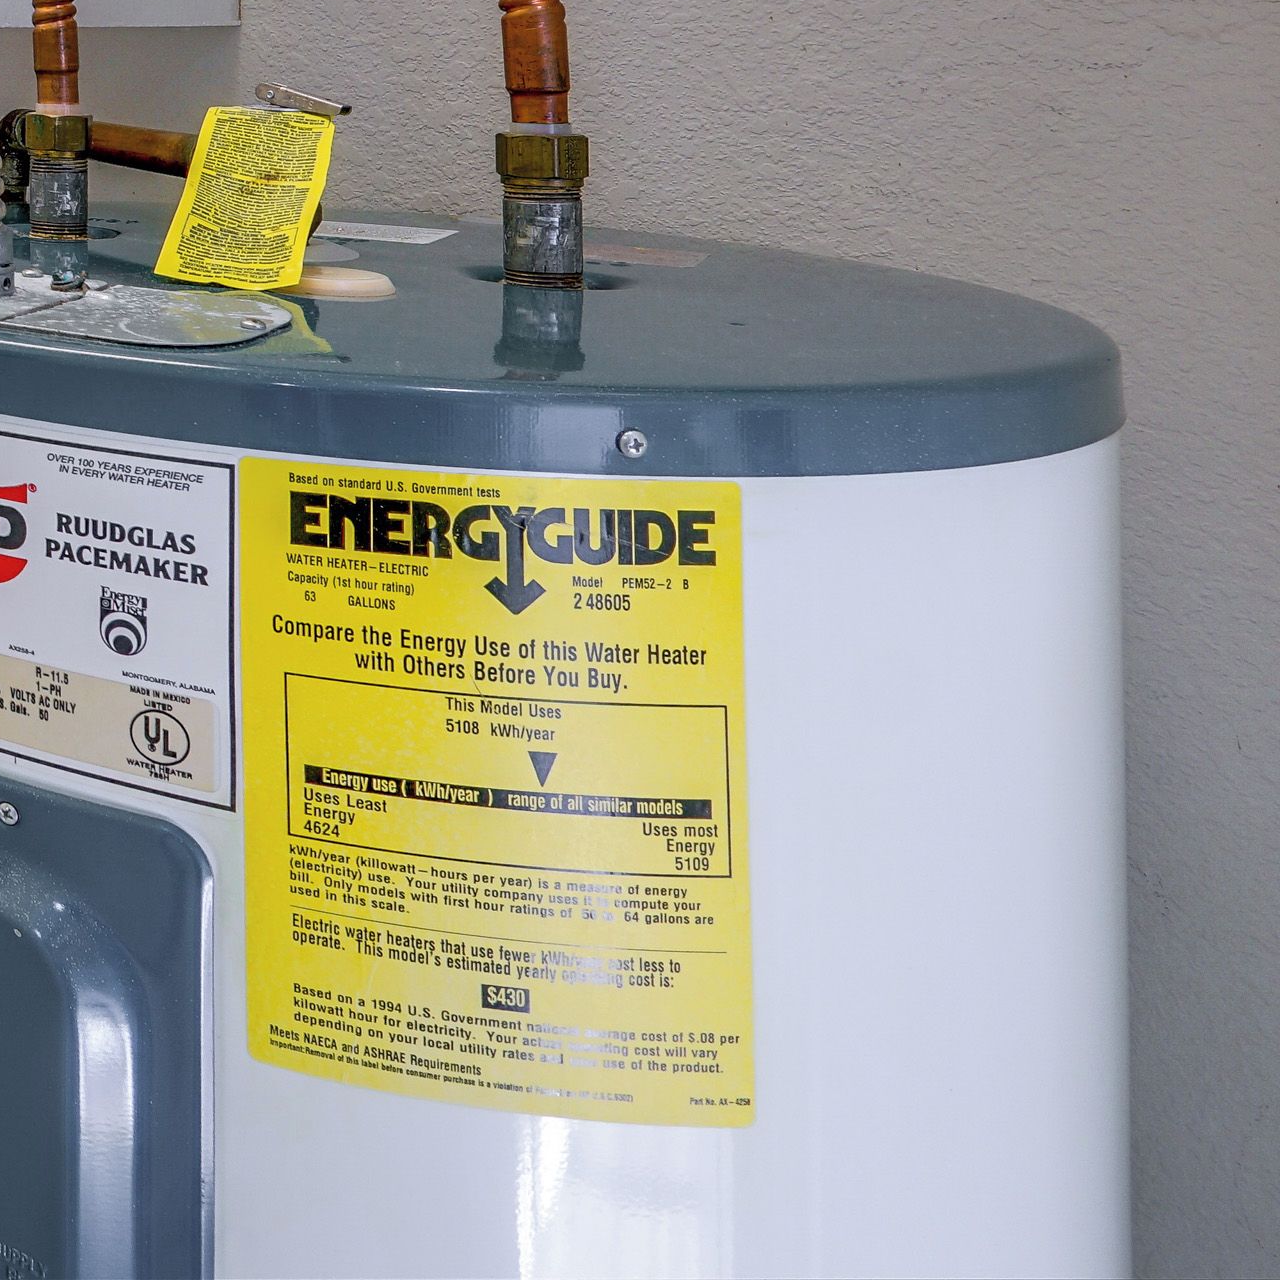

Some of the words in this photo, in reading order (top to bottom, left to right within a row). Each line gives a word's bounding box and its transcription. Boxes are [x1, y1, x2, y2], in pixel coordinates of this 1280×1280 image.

[47, 453, 75, 465] OVER
[78, 458, 94, 467] 100
[97, 461, 132, 474] YEARS
[134, 466, 204, 484] EXPERIENCE
[59, 464, 68, 473] IN
[71, 466, 106, 479] EVERY
[108, 472, 144, 485] WATER
[147, 478, 190, 492] HEATER
[289, 472, 318, 485] Based
[322, 477, 334, 487] on
[339, 477, 381, 491] standard
[386, 481, 407, 492] U.S.
[412, 483, 472, 497] Government
[477, 487, 501, 498] tests
[56, 512, 196, 555] RUUDGLAS
[290, 491, 716, 566] ENERGYGUIDE
[45, 537, 209, 586] PACEMAKER
[287, 552, 323, 567] WATER
[288, 571, 328, 586] Capacity
[333, 576, 351, 589] (1st
[355, 578, 378, 591] hour
[382, 581, 415, 596] rating)
[572, 576, 603, 588] Model
[683, 579, 689, 590] B
[100, 585, 141, 606] Energy
[304, 591, 316, 602] 63
[348, 595, 396, 610] GALLONS
[272, 614, 354, 642] Compare
[362, 625, 392, 647] the
[400, 629, 466, 658] Energy
[475, 635, 510, 657] Use
[519, 639, 536, 659] of
[543, 641, 577, 662] this
[585, 642, 640, 664] Water
[648, 644, 707, 665] Heater
[122, 670, 177, 688] MONTGOMERY,
[179, 682, 215, 695] ALABAMA
[355, 650, 394, 672] with
[403, 654, 465, 679] Others
[474, 661, 536, 685] Before
[543, 665, 579, 687] You
[588, 668, 628, 694] Buy.
[10, 687, 36, 704] VOLTS
[39, 695, 50, 708] AC
[53, 698, 77, 714] ONLY
[130, 685, 150, 696] MADE
[153, 689, 160, 699] IN
[162, 691, 191, 704] MEXICO
[144, 699, 173, 711] LISTED
[39, 708, 49, 721] 50
[445, 696, 474, 713] This
[480, 699, 522, 716] Model
[529, 703, 562, 719] Uses
[143, 715, 177, 759] UL
[446, 719, 480, 735] 5108
[490, 723, 555, 742] kWh/year
[126, 758, 156, 771] WATER
[159, 764, 192, 780] HEATER
[304, 787, 340, 806] Uses
[347, 794, 387, 813] Least
[322, 767, 369, 791] Energy
[372, 778, 397, 793] use
[507, 793, 545, 811] range
[551, 794, 562, 810] of
[567, 796, 582, 811] all
[587, 797, 632, 814] similar
[636, 800, 683, 816] models
[304, 803, 355, 825] Energy
[304, 820, 340, 837] 4624
[642, 822, 677, 837] Uses
[684, 824, 718, 838] most
[666, 839, 715, 856] Energy
[675, 857, 709, 871] 5109
[292, 913, 340, 935] Electric
[345, 923, 381, 941] water
[387, 930, 435, 951] heaters
[440, 938, 466, 955] that
[471, 946, 493, 959] use
[499, 946, 536, 963] fewer
[639, 957, 664, 972] less
[669, 959, 681, 972] to
[487, 986, 525, 1008] $430
[410, 1055, 481, 1076] Requirements
